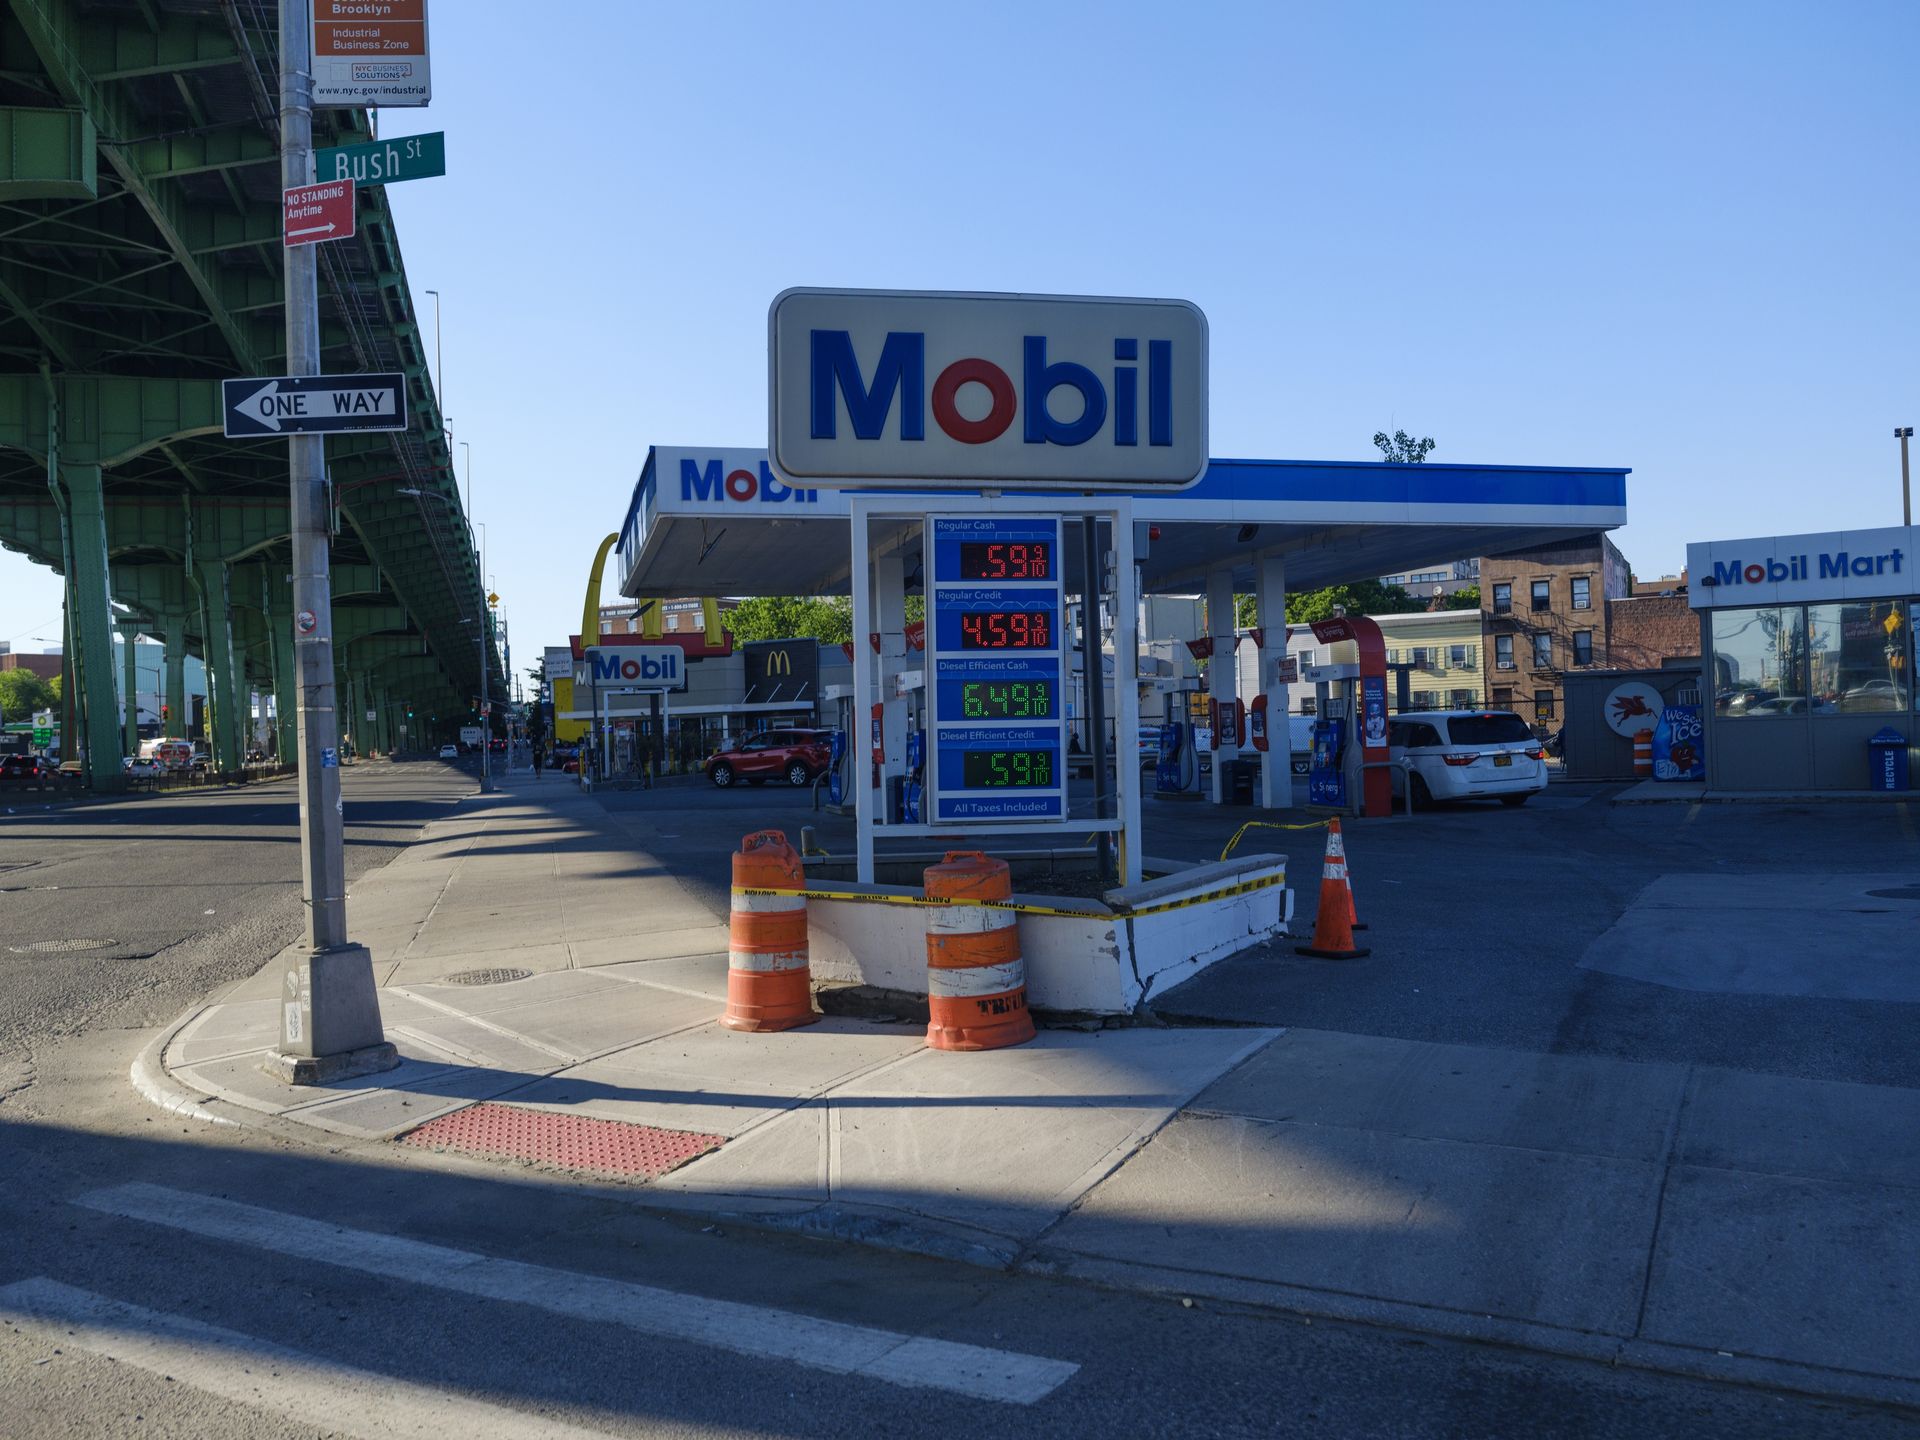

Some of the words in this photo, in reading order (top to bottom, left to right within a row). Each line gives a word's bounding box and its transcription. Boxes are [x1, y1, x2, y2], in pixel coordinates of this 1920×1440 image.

[332, 4, 391, 16] Brooklyn
[332, 28, 381, 38] Industrial
[333, 40, 381, 49] Business
[383, 40, 410, 49] Zone
[318, 85, 427, 96] www.nyc.gov/industrial
[335, 144, 400, 182] Bush
[406, 138, 422, 159] St
[287, 194, 300, 206] NO
[301, 186, 344, 204] STANDING
[287, 204, 323, 220] Anytime
[810, 329, 1173, 447] Mobil
[259, 394, 308, 417] ONE
[332, 391, 385, 414] WAY
[937, 521, 972, 531] Regular
[973, 521, 996, 530] Cash
[1713, 555, 1808, 586] Mobil
[1819, 548, 1904, 579] Mart
[938, 591, 973, 601] Regular
[974, 591, 1002, 600] Credit
[963, 614, 1029, 647] 4.59
[594, 654, 677, 680] Mobil
[939, 661, 967, 670] Diesel
[968, 660, 1008, 670] Efficient
[1009, 660, 1029, 670] Cash
[964, 683, 1030, 716] 6.49
[1665, 708, 1684, 722] We
[1681, 713, 1702, 726] Se
[940, 731, 968, 740] Diesel
[969, 730, 1007, 740] Efficient
[1008, 730, 1035, 740] Credit
[1670, 722, 1702, 746] Ice
[1884, 750, 1896, 789] RECYCLE
[953, 803, 968, 813] All
[972, 803, 1001, 812] Taxes
[1003, 802, 1048, 812] Included
